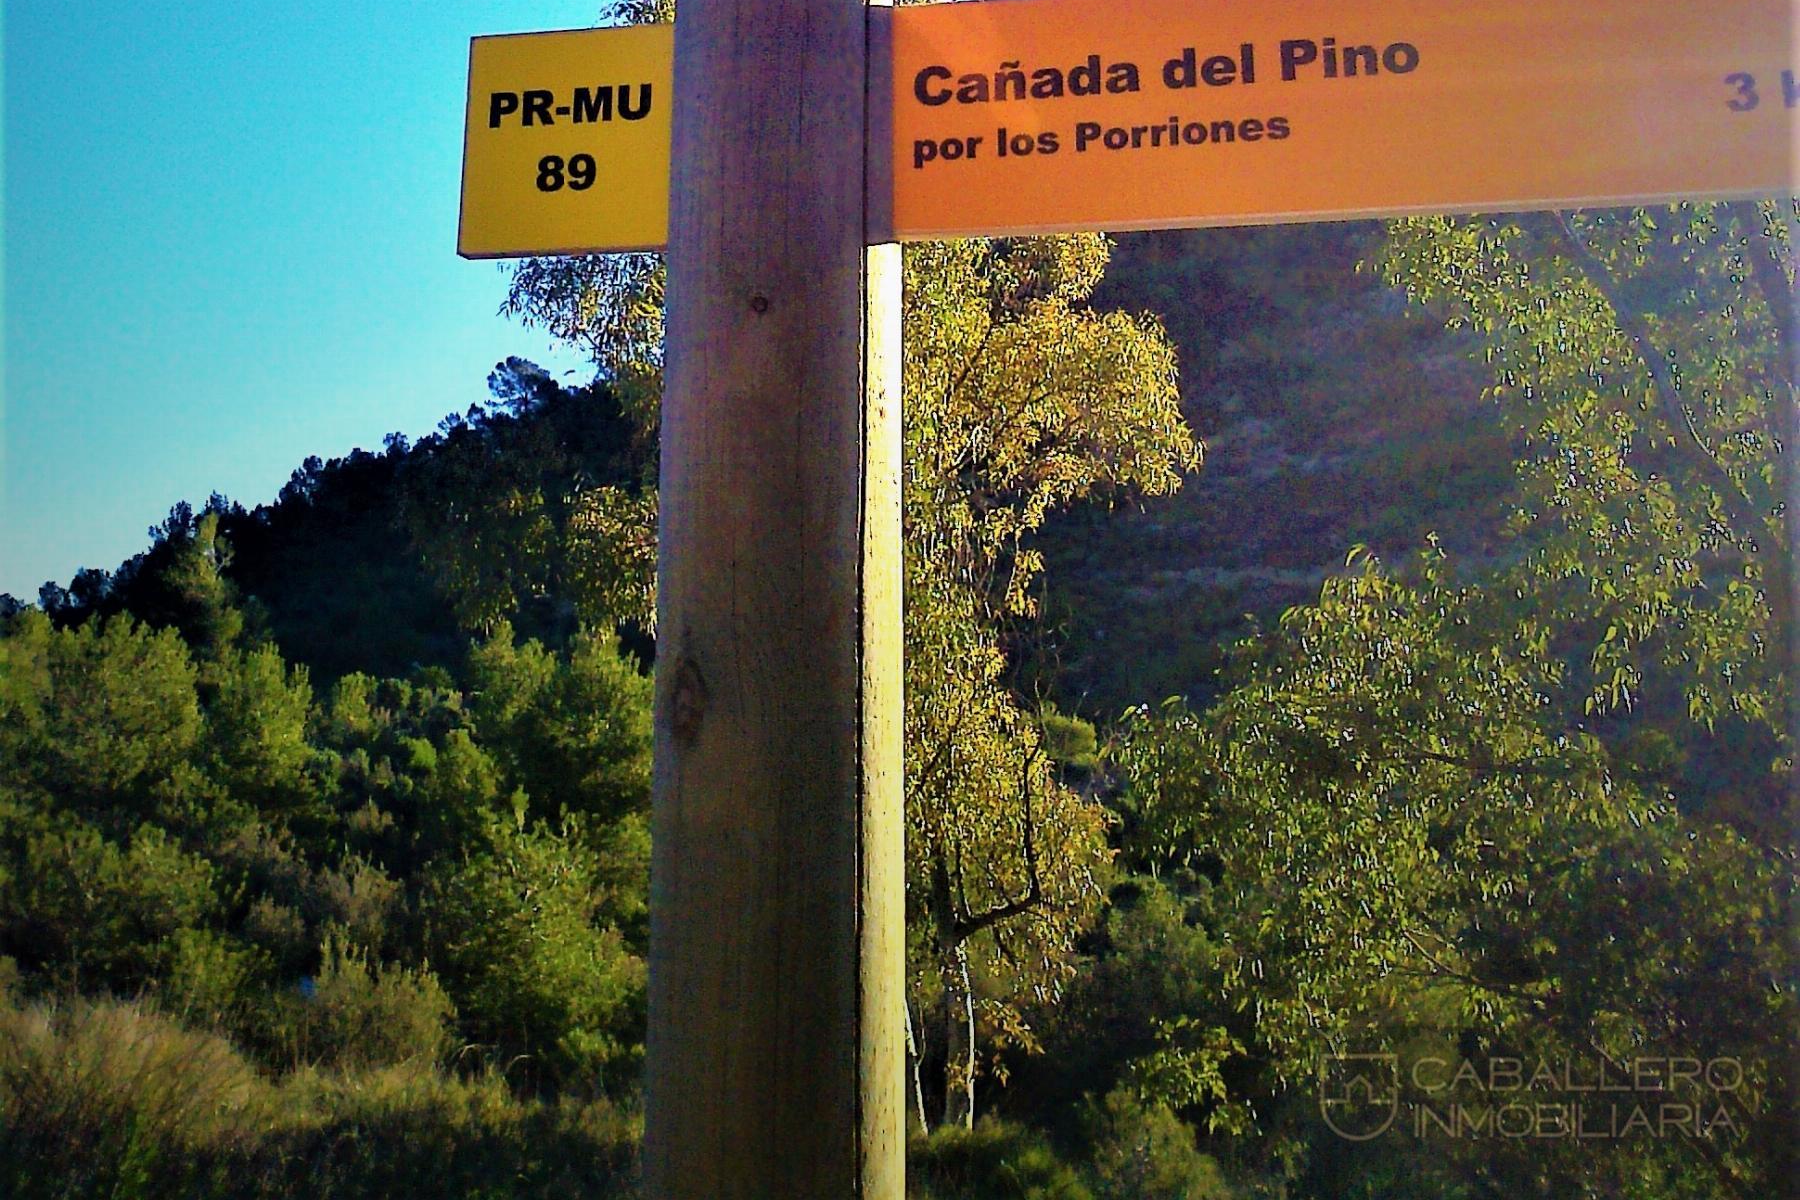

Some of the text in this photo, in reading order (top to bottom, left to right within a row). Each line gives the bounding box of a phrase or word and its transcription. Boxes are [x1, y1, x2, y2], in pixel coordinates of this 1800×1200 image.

[914, 37, 1420, 107] Cañada del Pino
[1724, 71, 1760, 112] 3
[488, 83, 653, 129] PR-MU
[913, 115, 1291, 169] por los Porriones
[536, 153, 597, 193] 89
